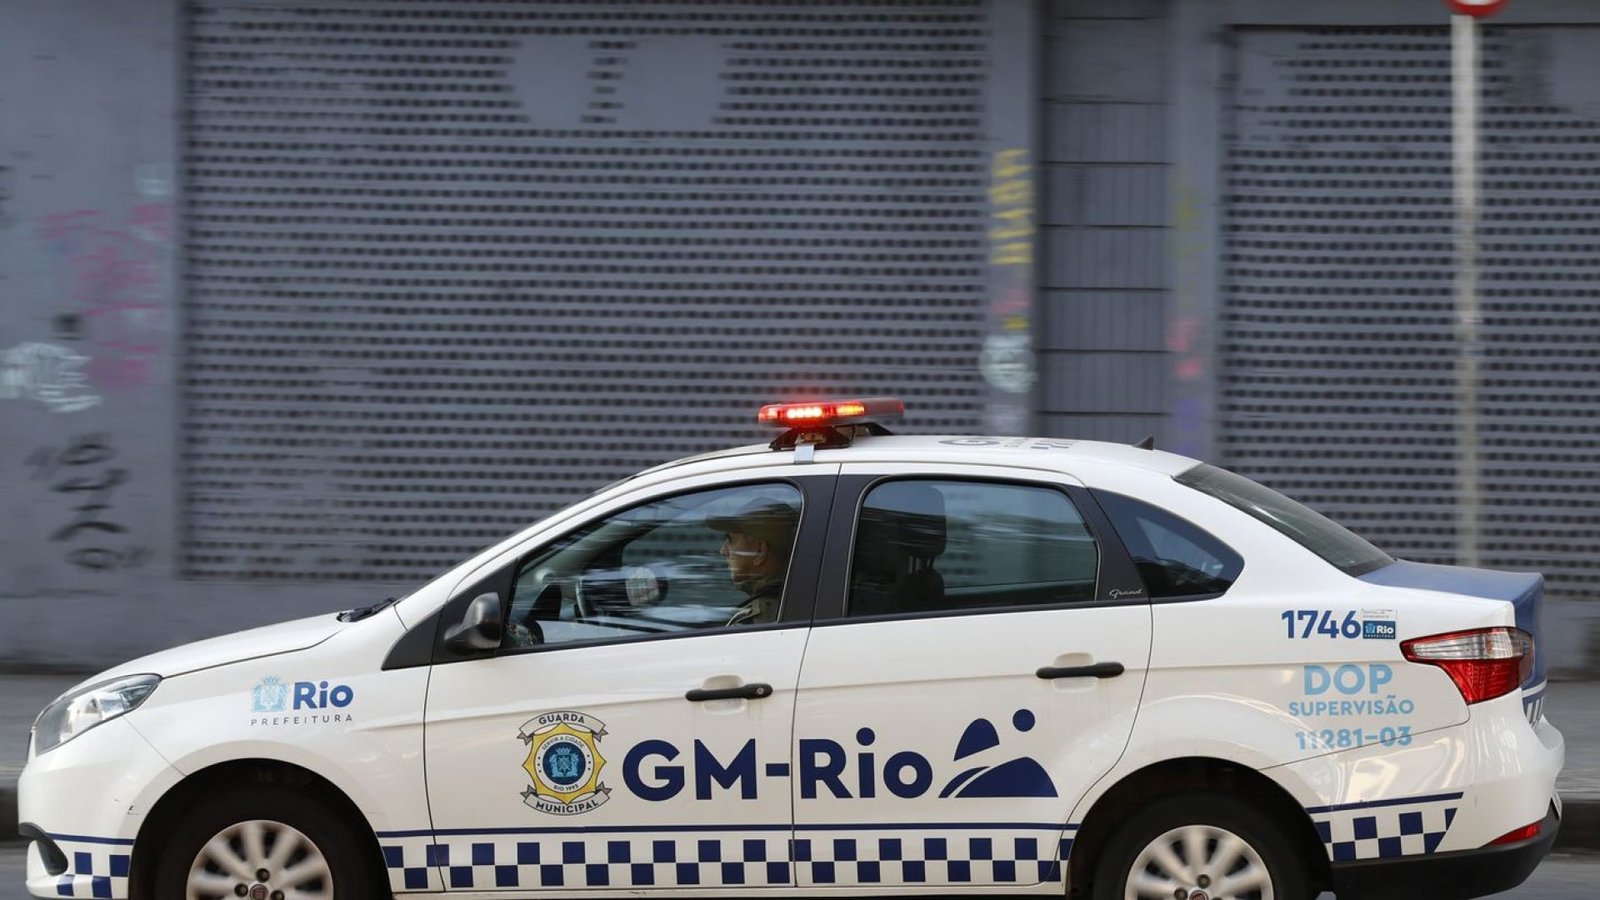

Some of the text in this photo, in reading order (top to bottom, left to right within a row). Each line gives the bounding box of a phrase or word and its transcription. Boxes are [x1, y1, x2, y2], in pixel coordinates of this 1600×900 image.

[1282, 610, 1361, 639] 1746
[1376, 625, 1394, 634] Rio
[1304, 664, 1393, 695] DOP
[293, 681, 354, 710] Rio
[1288, 695, 1415, 716] SUPERVISÃO
[250, 714, 353, 726] PREFEITURA
[538, 713, 585, 724] GUARDA
[1295, 726, 1413, 750] 11281-03
[622, 727, 933, 802] GM-Rio
[535, 800, 598, 813] MUNICIPAL
